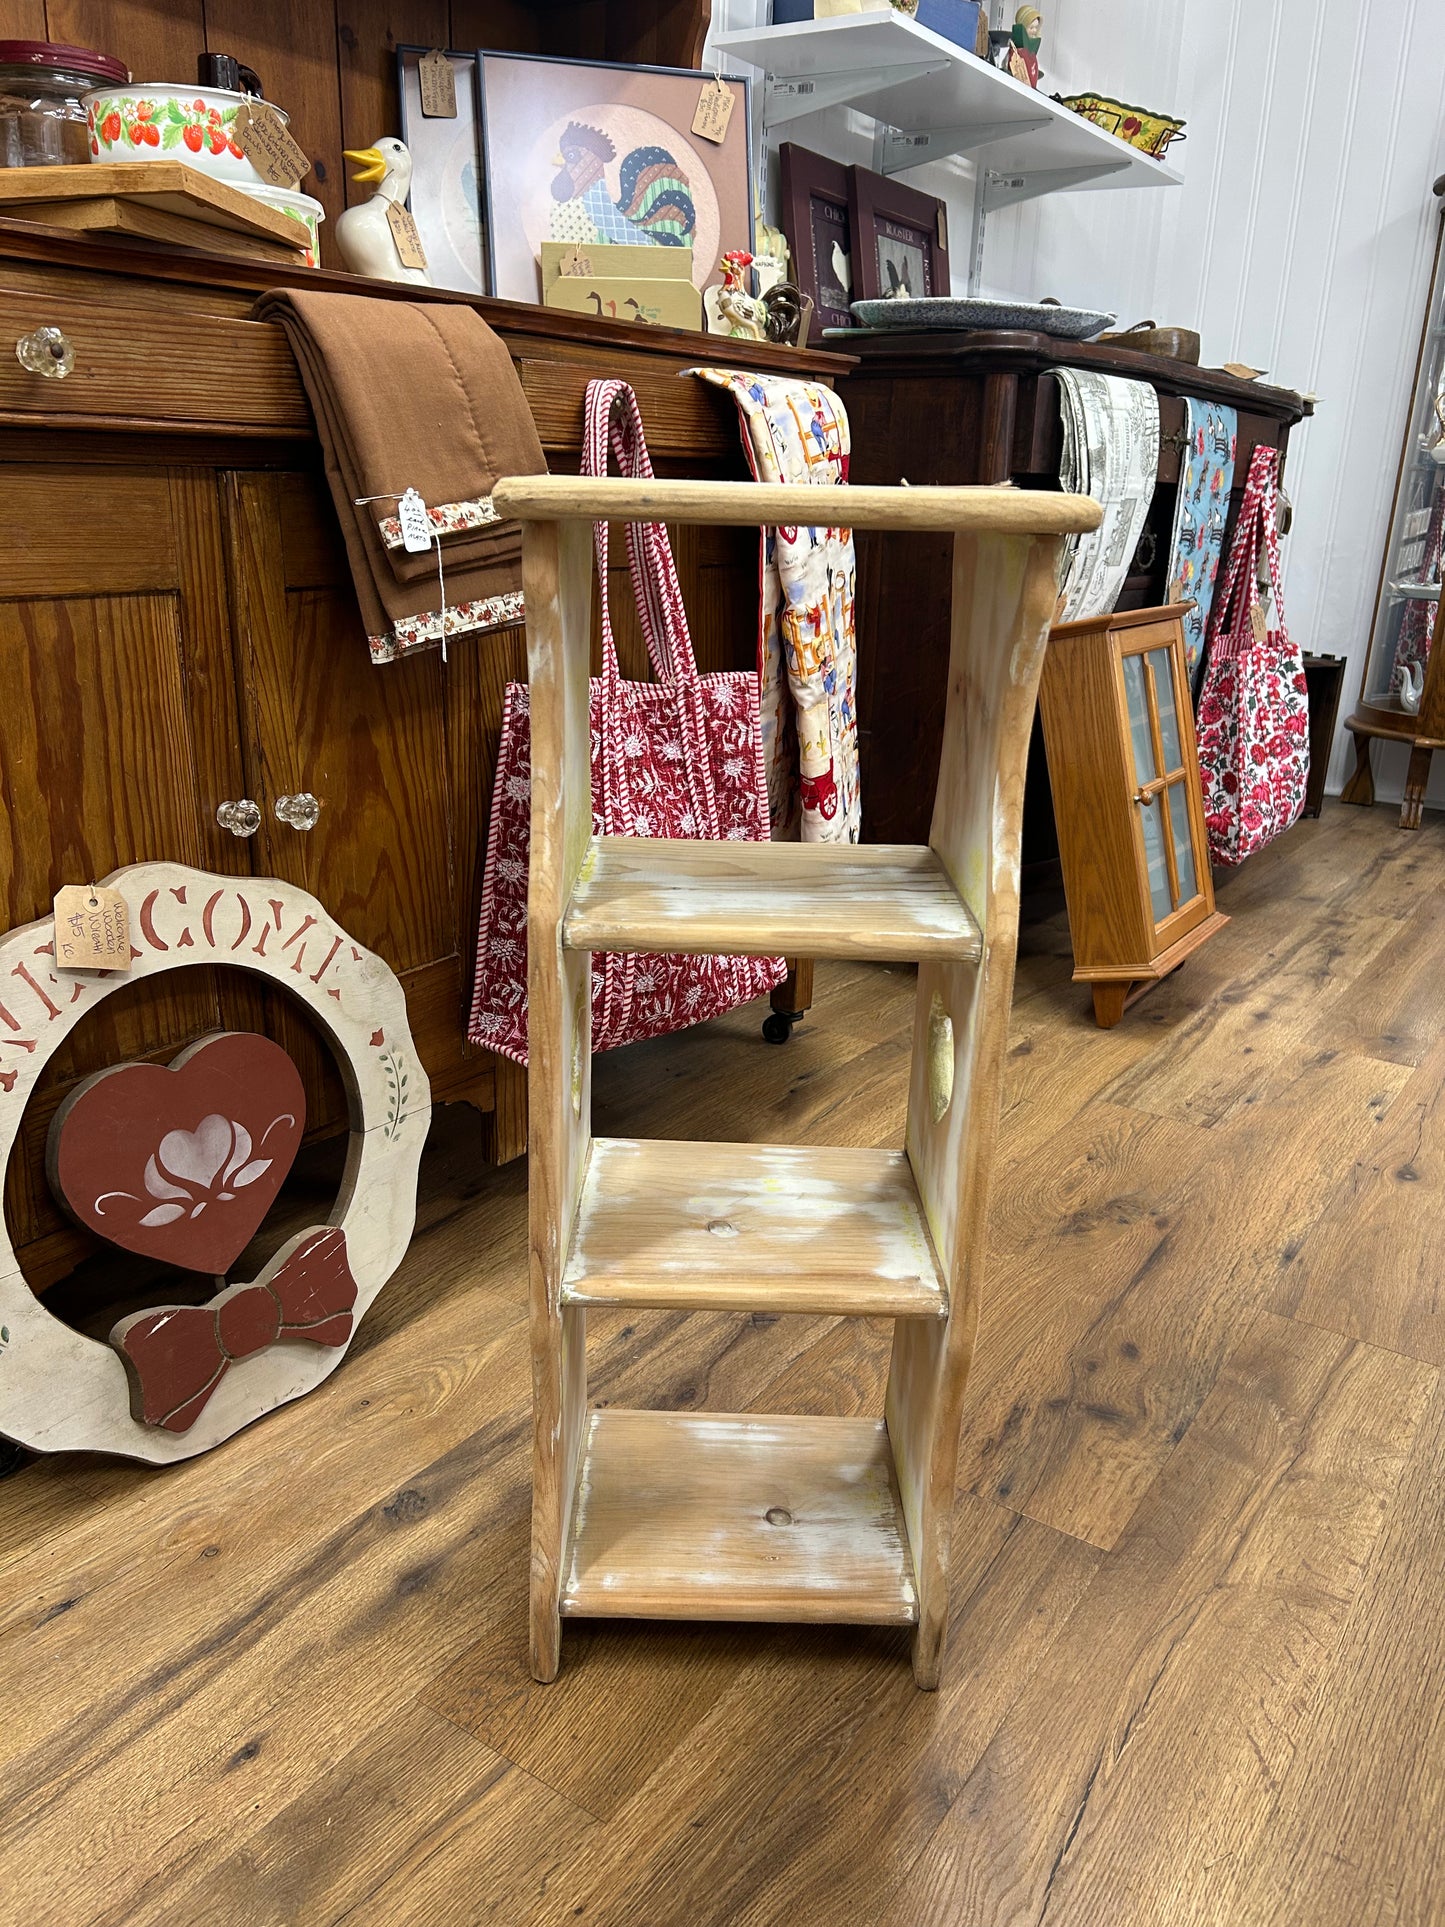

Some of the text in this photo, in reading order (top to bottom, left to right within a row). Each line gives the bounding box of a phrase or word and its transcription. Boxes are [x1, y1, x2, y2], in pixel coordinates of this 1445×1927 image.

[67, 912, 85, 938] $15
[89, 913, 103, 955] Wreath
[103, 910, 116, 955] Wooden
[113, 902, 125, 955] Welcome
[61, 943, 74, 959] KC
